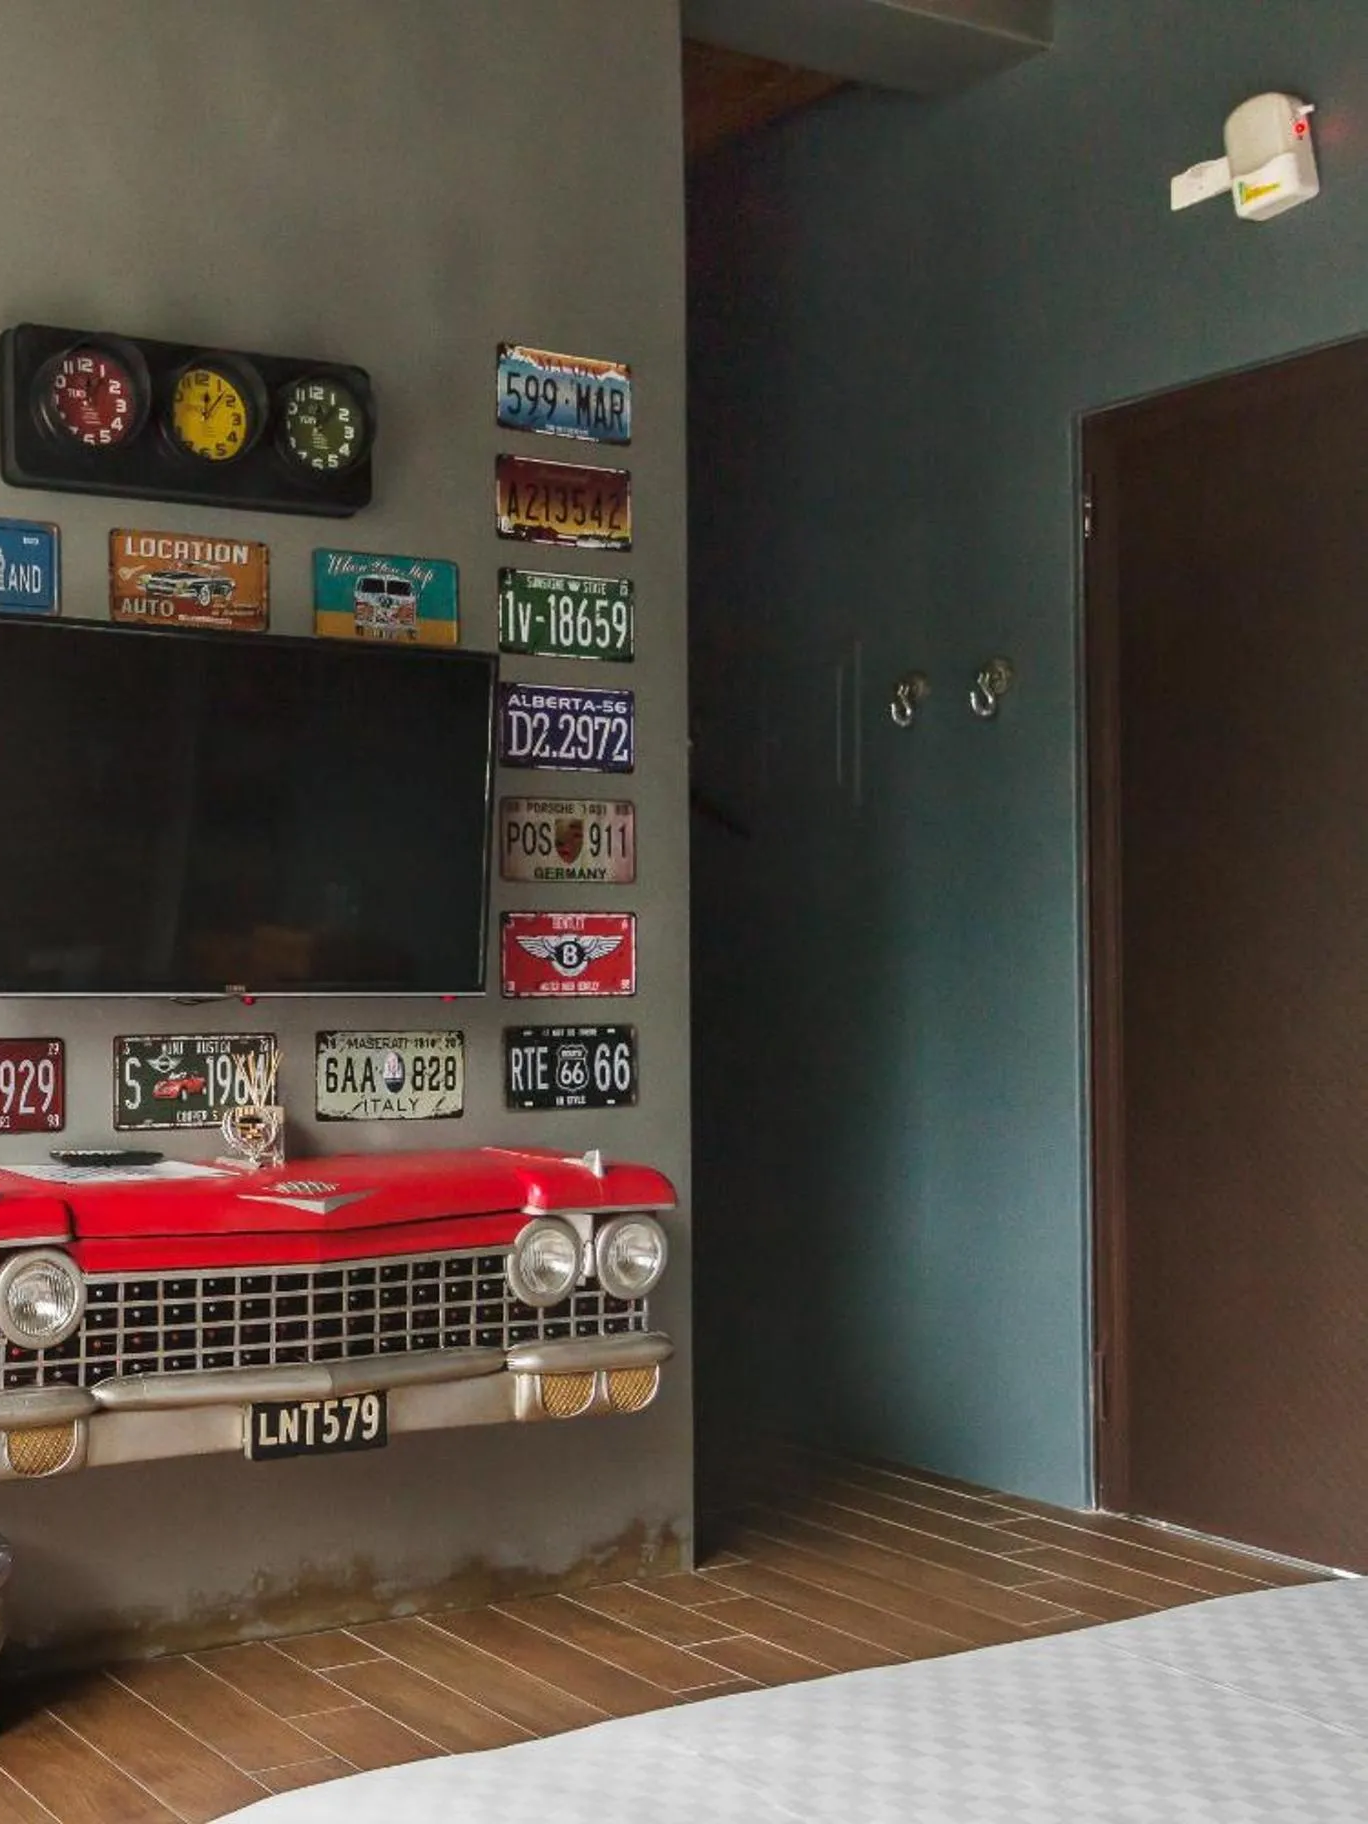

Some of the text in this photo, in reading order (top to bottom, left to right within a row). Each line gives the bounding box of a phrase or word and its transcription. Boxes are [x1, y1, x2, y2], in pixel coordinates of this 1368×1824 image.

[125, 535, 249, 565] LOCATION
[121, 597, 175, 617] AUTO
[506, 821, 627, 858] POS 911
[534, 866, 607, 880] GERMANY
[347, 1037, 409, 1050] MASERATI
[411, 1055, 457, 1092] 828
[511, 1042, 631, 1092] RTE 66
[560, 1060, 585, 1085] 66
[362, 1097, 420, 1113] ITALY
[258, 1394, 381, 1447] LNT579
